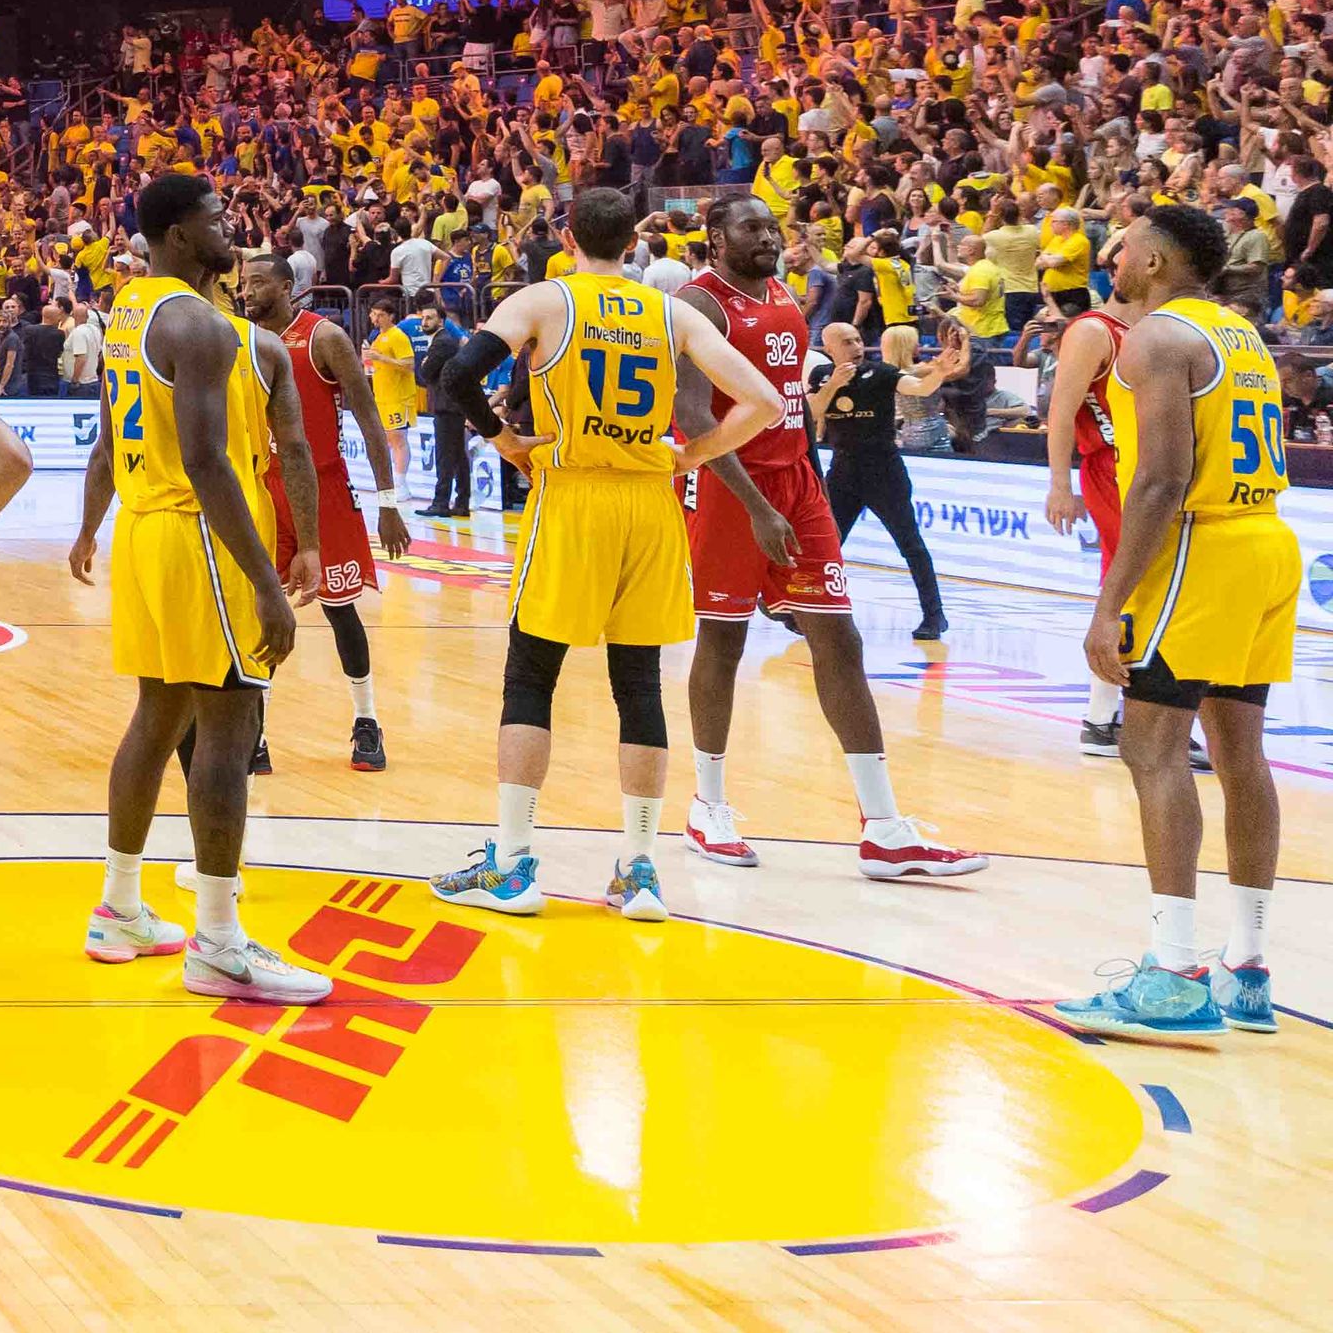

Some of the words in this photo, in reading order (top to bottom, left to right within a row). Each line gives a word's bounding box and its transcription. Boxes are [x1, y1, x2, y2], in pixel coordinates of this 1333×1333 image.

[598, 293, 644, 318] כהן
[765, 332, 798, 366] 32
[581, 348, 658, 417] 15
[787, 398, 797, 413] IT
[1231, 399, 1286, 477] 50
[943, 504, 1029, 540] אשראי
[325, 560, 363, 593] 52
